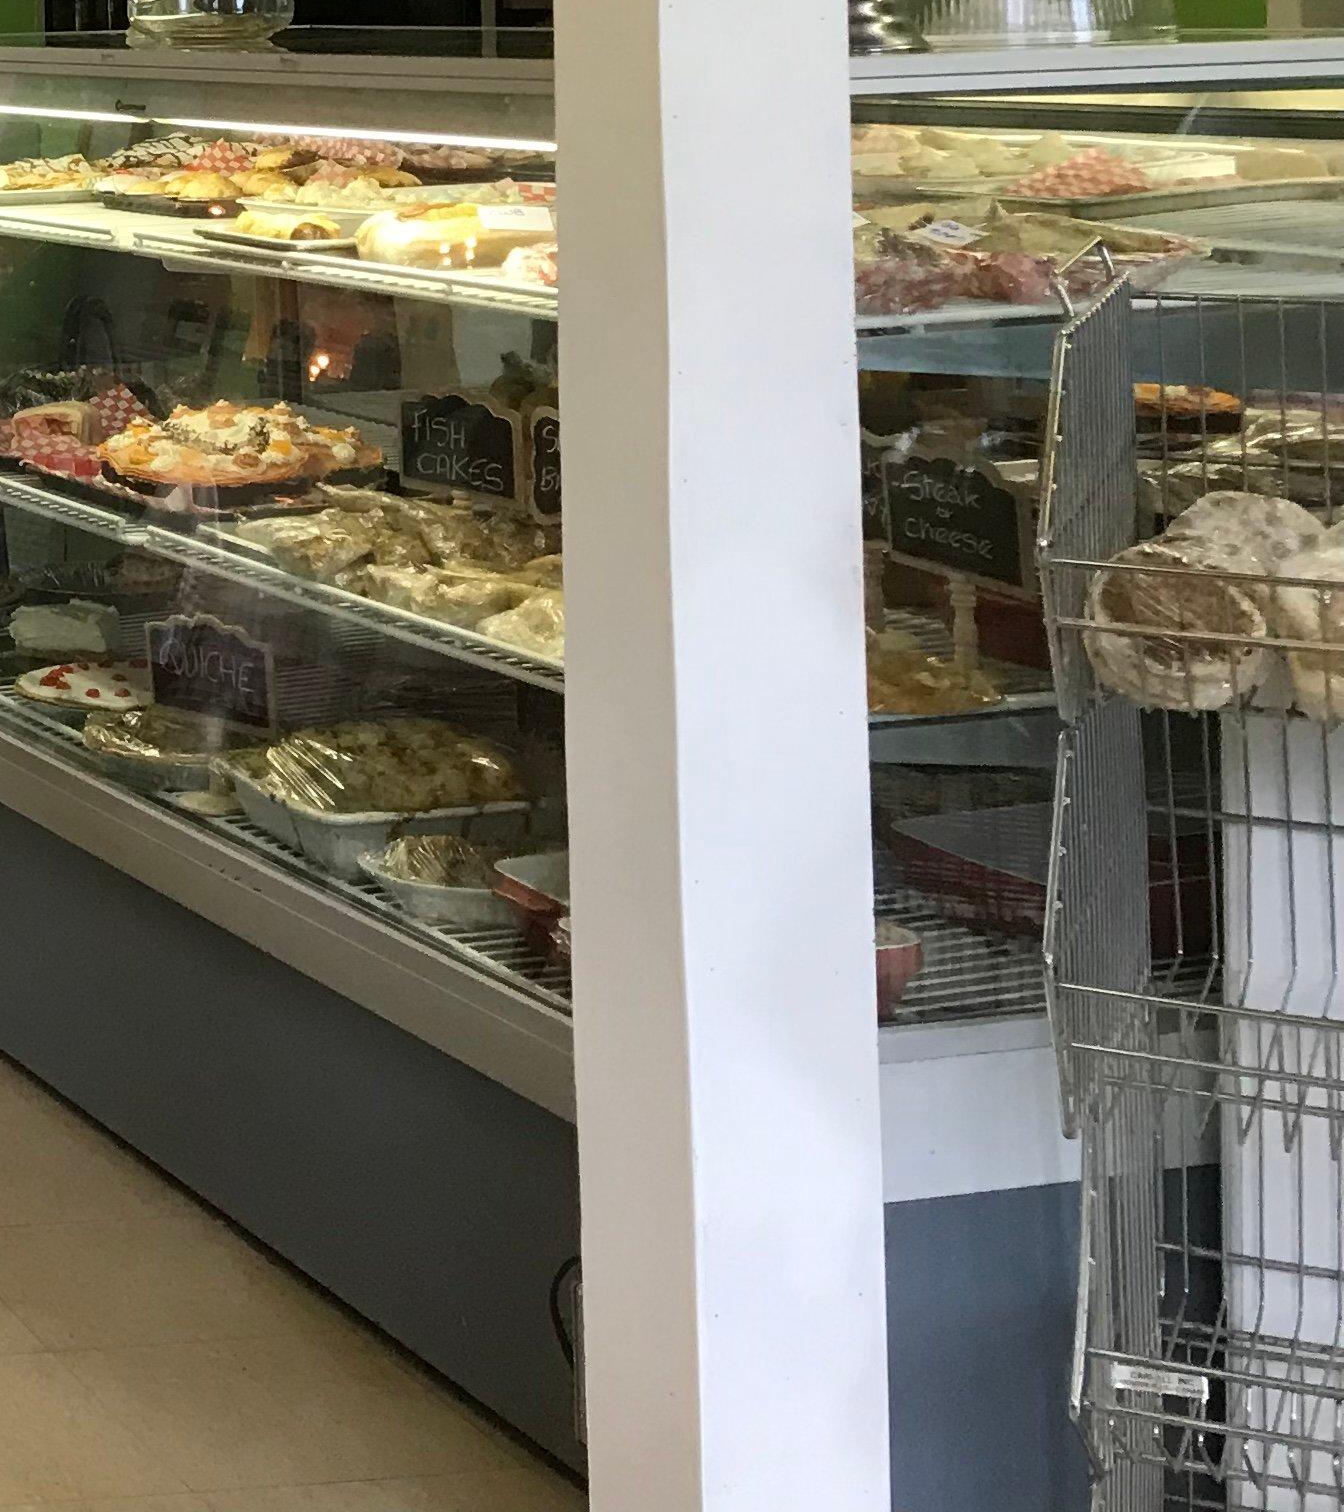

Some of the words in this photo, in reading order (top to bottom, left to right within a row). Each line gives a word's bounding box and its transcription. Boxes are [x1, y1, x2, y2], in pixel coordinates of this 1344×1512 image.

[412, 408, 465, 449] FISH
[416, 452, 504, 492] CAKES
[892, 470, 981, 509] Steak
[159, 637, 255, 693] QUICHE
